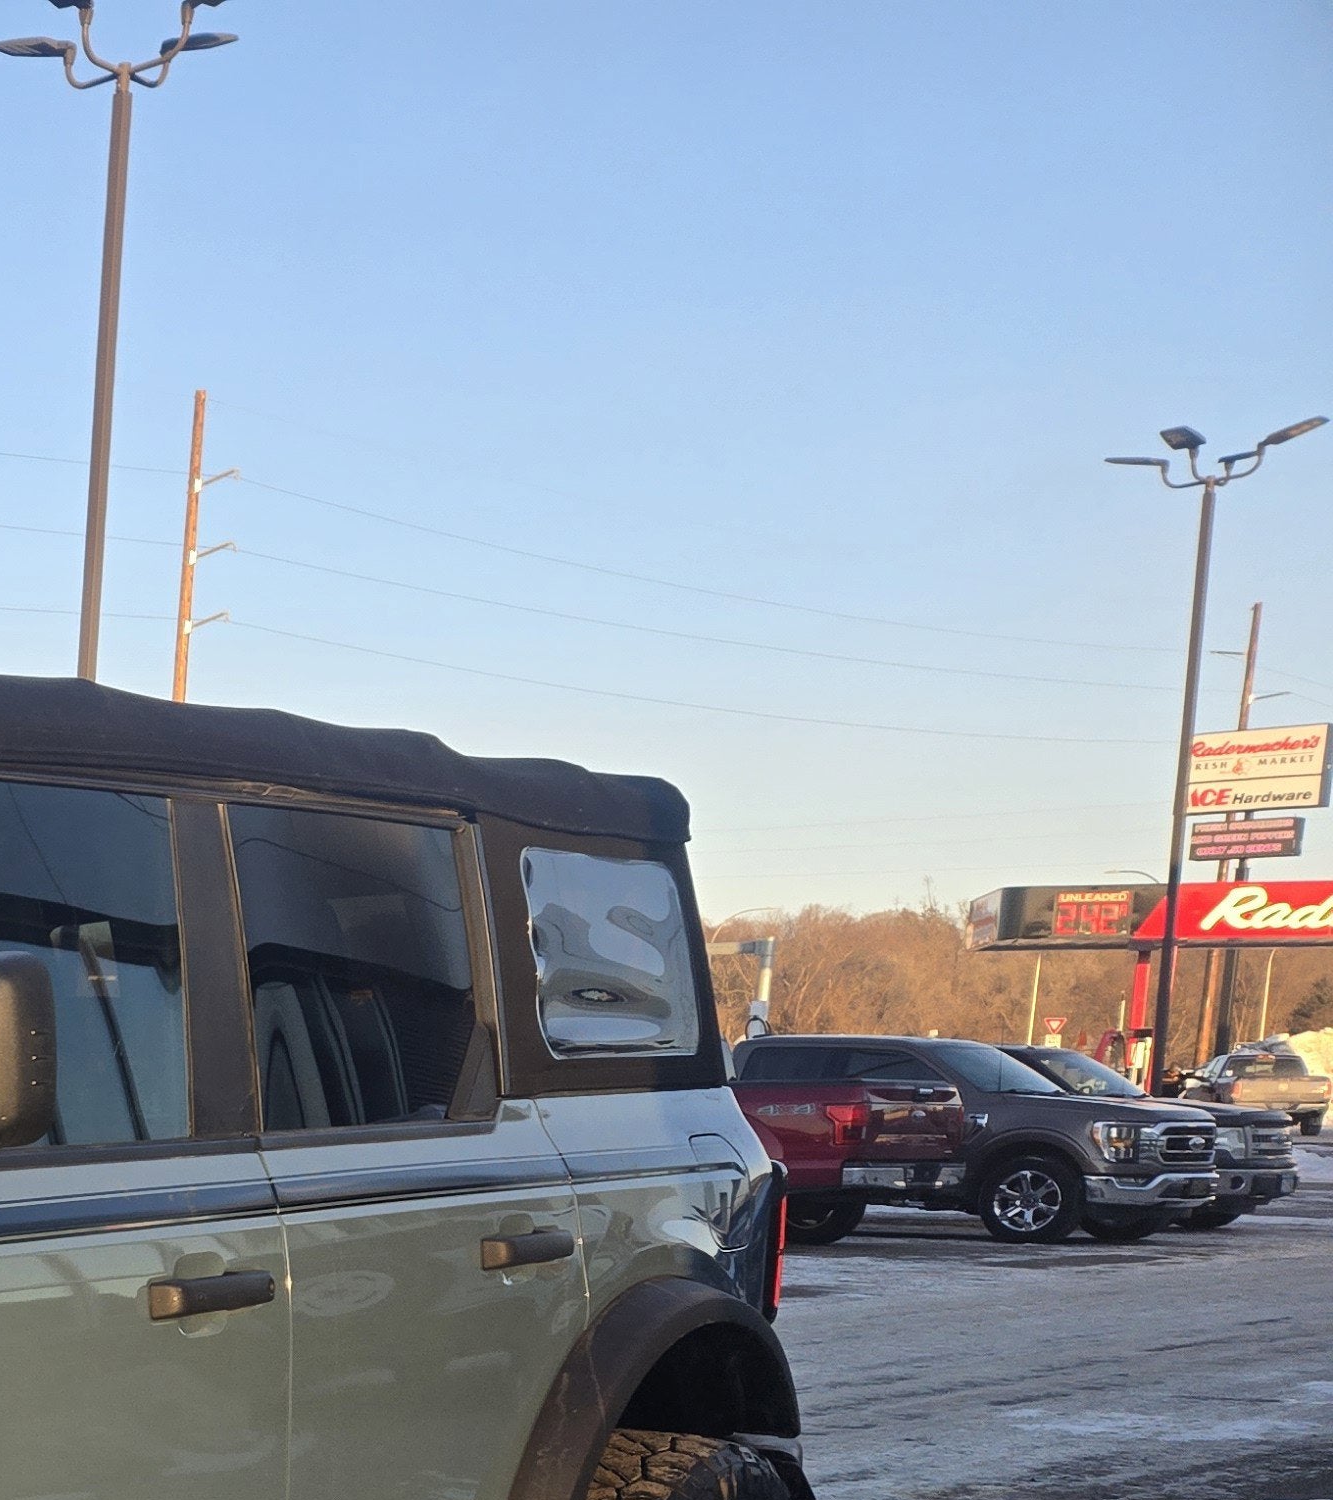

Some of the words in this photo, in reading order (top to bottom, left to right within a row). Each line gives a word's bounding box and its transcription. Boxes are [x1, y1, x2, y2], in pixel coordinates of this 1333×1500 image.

[1194, 761, 1228, 771] RESH
[1257, 754, 1315, 766] MARKET
[1232, 790, 1313, 805] Hardware
[1060, 892, 1129, 902] UNLEADED
